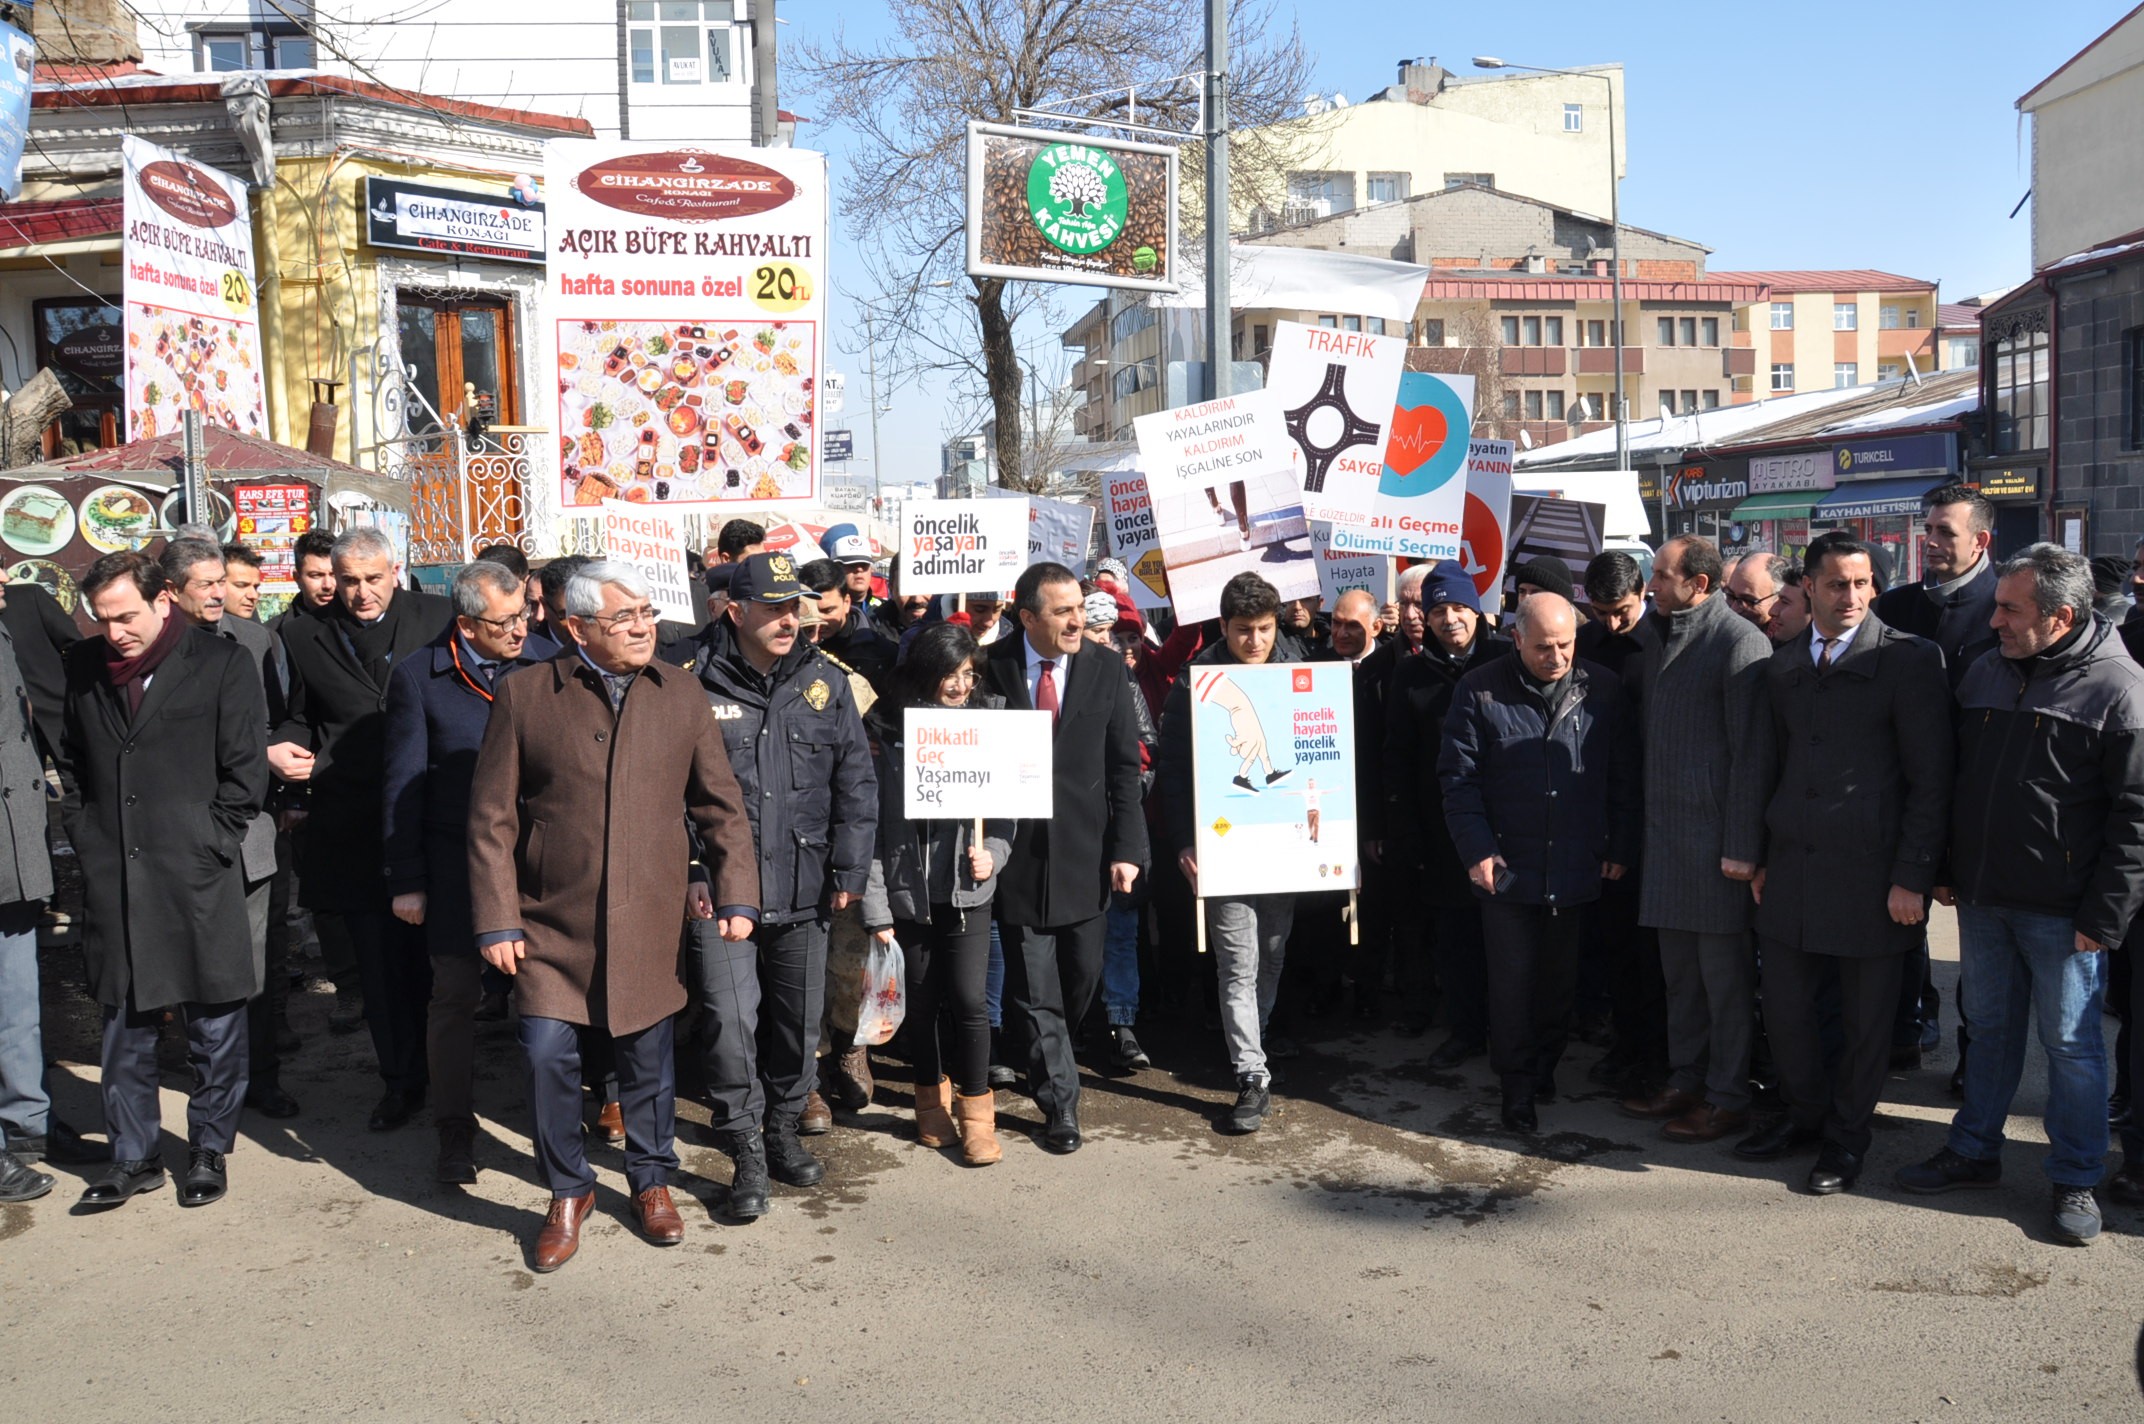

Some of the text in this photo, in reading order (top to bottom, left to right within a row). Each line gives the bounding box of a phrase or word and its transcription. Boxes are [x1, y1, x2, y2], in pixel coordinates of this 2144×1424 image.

[1041, 144, 1115, 179] YEMEN
[150, 174, 227, 209] CİHANGİRZADE
[601, 174, 771, 192] CİHANGİRZADE
[409, 201, 532, 232] CİHANGİRZADE
[1035, 207, 1119, 249] KAHVESİ
[129, 219, 248, 270] AÇIK BÜFE KAHVALTI
[418, 237, 530, 259] Cafe & Restaurant
[559, 226, 812, 259] AÇIK BÜFE KAHVALTI
[130, 259, 219, 297] hafta sonuna özel
[224, 273, 244, 303] 20
[561, 273, 742, 296] hafta sonuna özel
[757, 266, 810, 301] 20 TL
[1307, 329, 1377, 359] TRAFİK
[1175, 399, 1235, 421] KALDIRIM
[1166, 413, 1255, 442] YAYALARINDIR
[1184, 434, 1245, 457] KALDIRIM
[1176, 449, 1263, 479] İŞGALİNE SON
[1338, 458, 1382, 476] SAYGI
[1853, 450, 1894, 464] TURKCELL
[1685, 467, 1704, 479] KARS
[1753, 458, 1816, 482] METRO
[239, 489, 305, 499] KARS EFE TUR
[1683, 478, 1747, 505] vipturizm
[1754, 479, 1816, 490] AYAKKABI
[1319, 507, 1366, 524] GÜZELDİR
[1820, 501, 1921, 519] KAYHAN İLETİŞİM
[606, 509, 675, 541] öncelik
[913, 513, 979, 535] öncelik
[1398, 515, 1459, 535] Geçme
[607, 533, 681, 563] hayatın
[913, 534, 987, 557] yaşayan
[1334, 529, 1457, 558] Ölümü Seçme
[912, 553, 985, 575] adımlar
[1331, 566, 1375, 582] Hayata
[1294, 707, 1335, 722] öncelik
[917, 727, 979, 746] Dikkatli
[1293, 722, 1338, 738] hayatın
[1294, 736, 1336, 750] öncelik
[916, 746, 944, 768] Geç
[1295, 750, 1341, 765] yayanın
[916, 766, 990, 788] Yaşamayı
[916, 784, 943, 807] Seç
